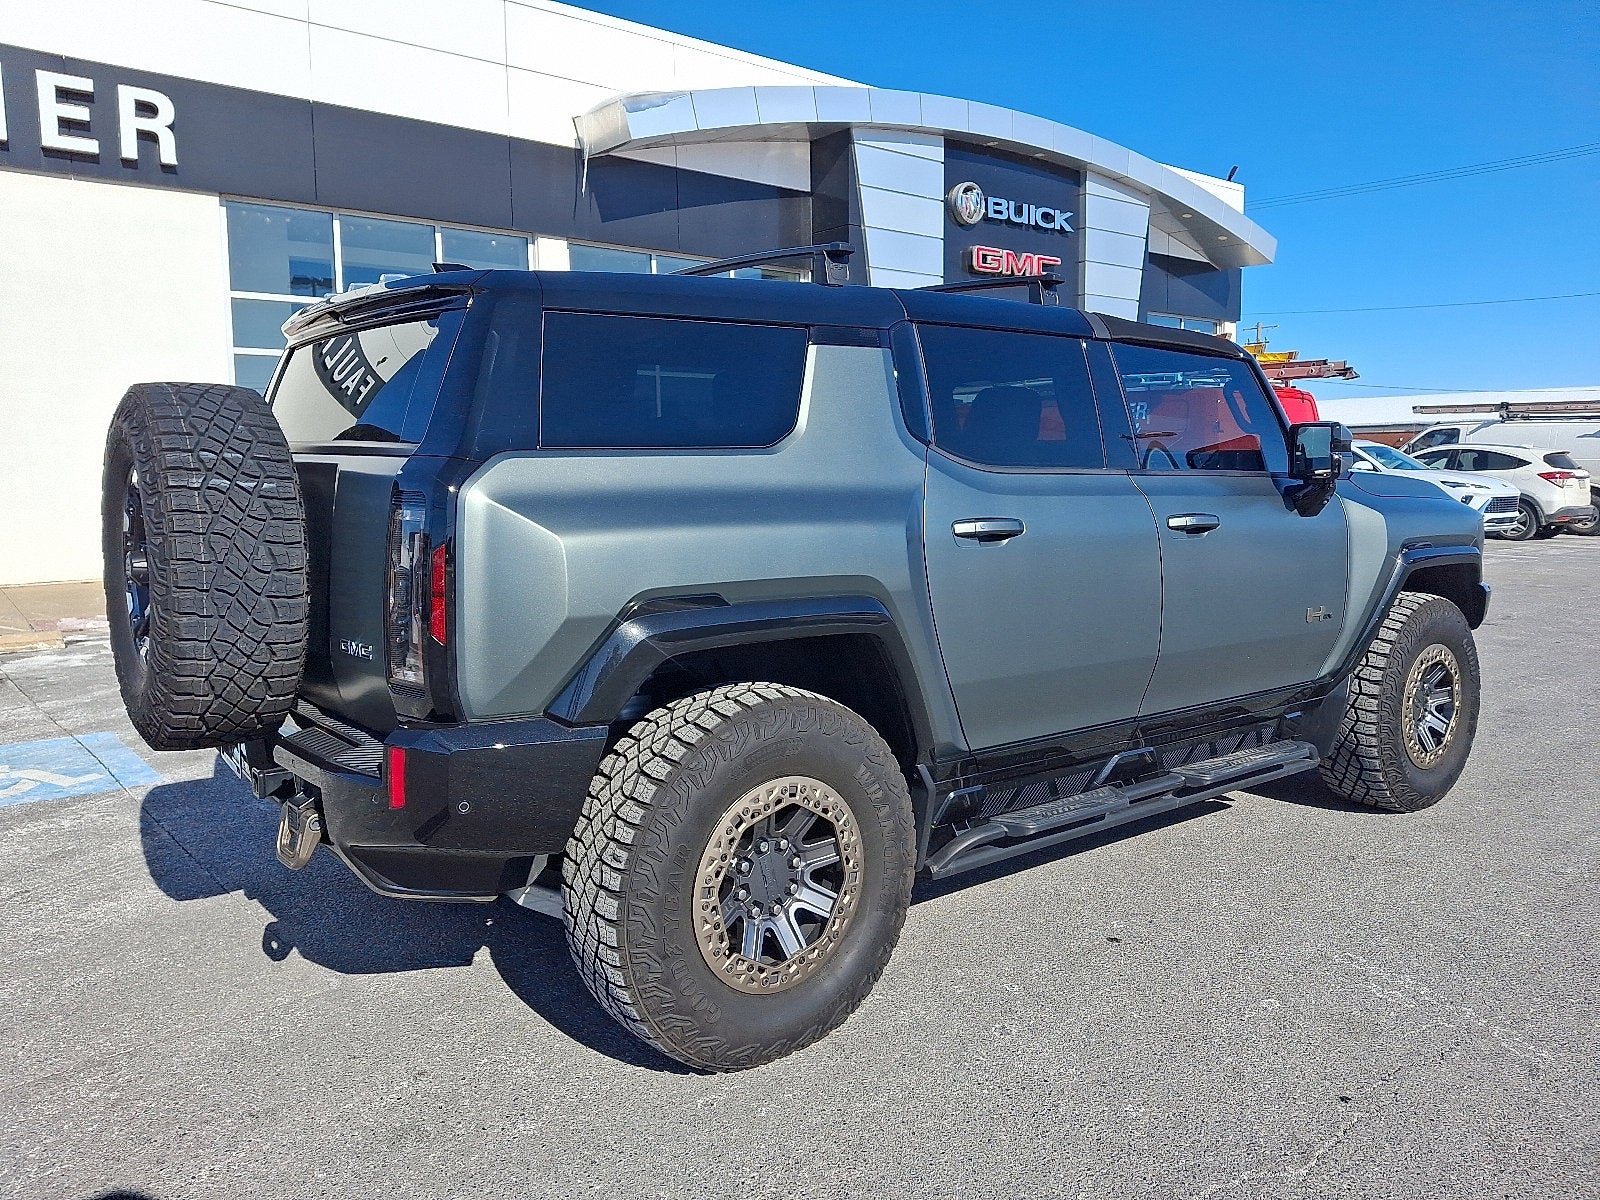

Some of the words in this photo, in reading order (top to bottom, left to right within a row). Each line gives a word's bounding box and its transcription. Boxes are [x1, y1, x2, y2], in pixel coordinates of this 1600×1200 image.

[0, 61, 178, 166] ER
[987, 196, 1074, 232] BUICK
[972, 245, 1062, 277] GMC
[339, 638, 373, 660] GMC
